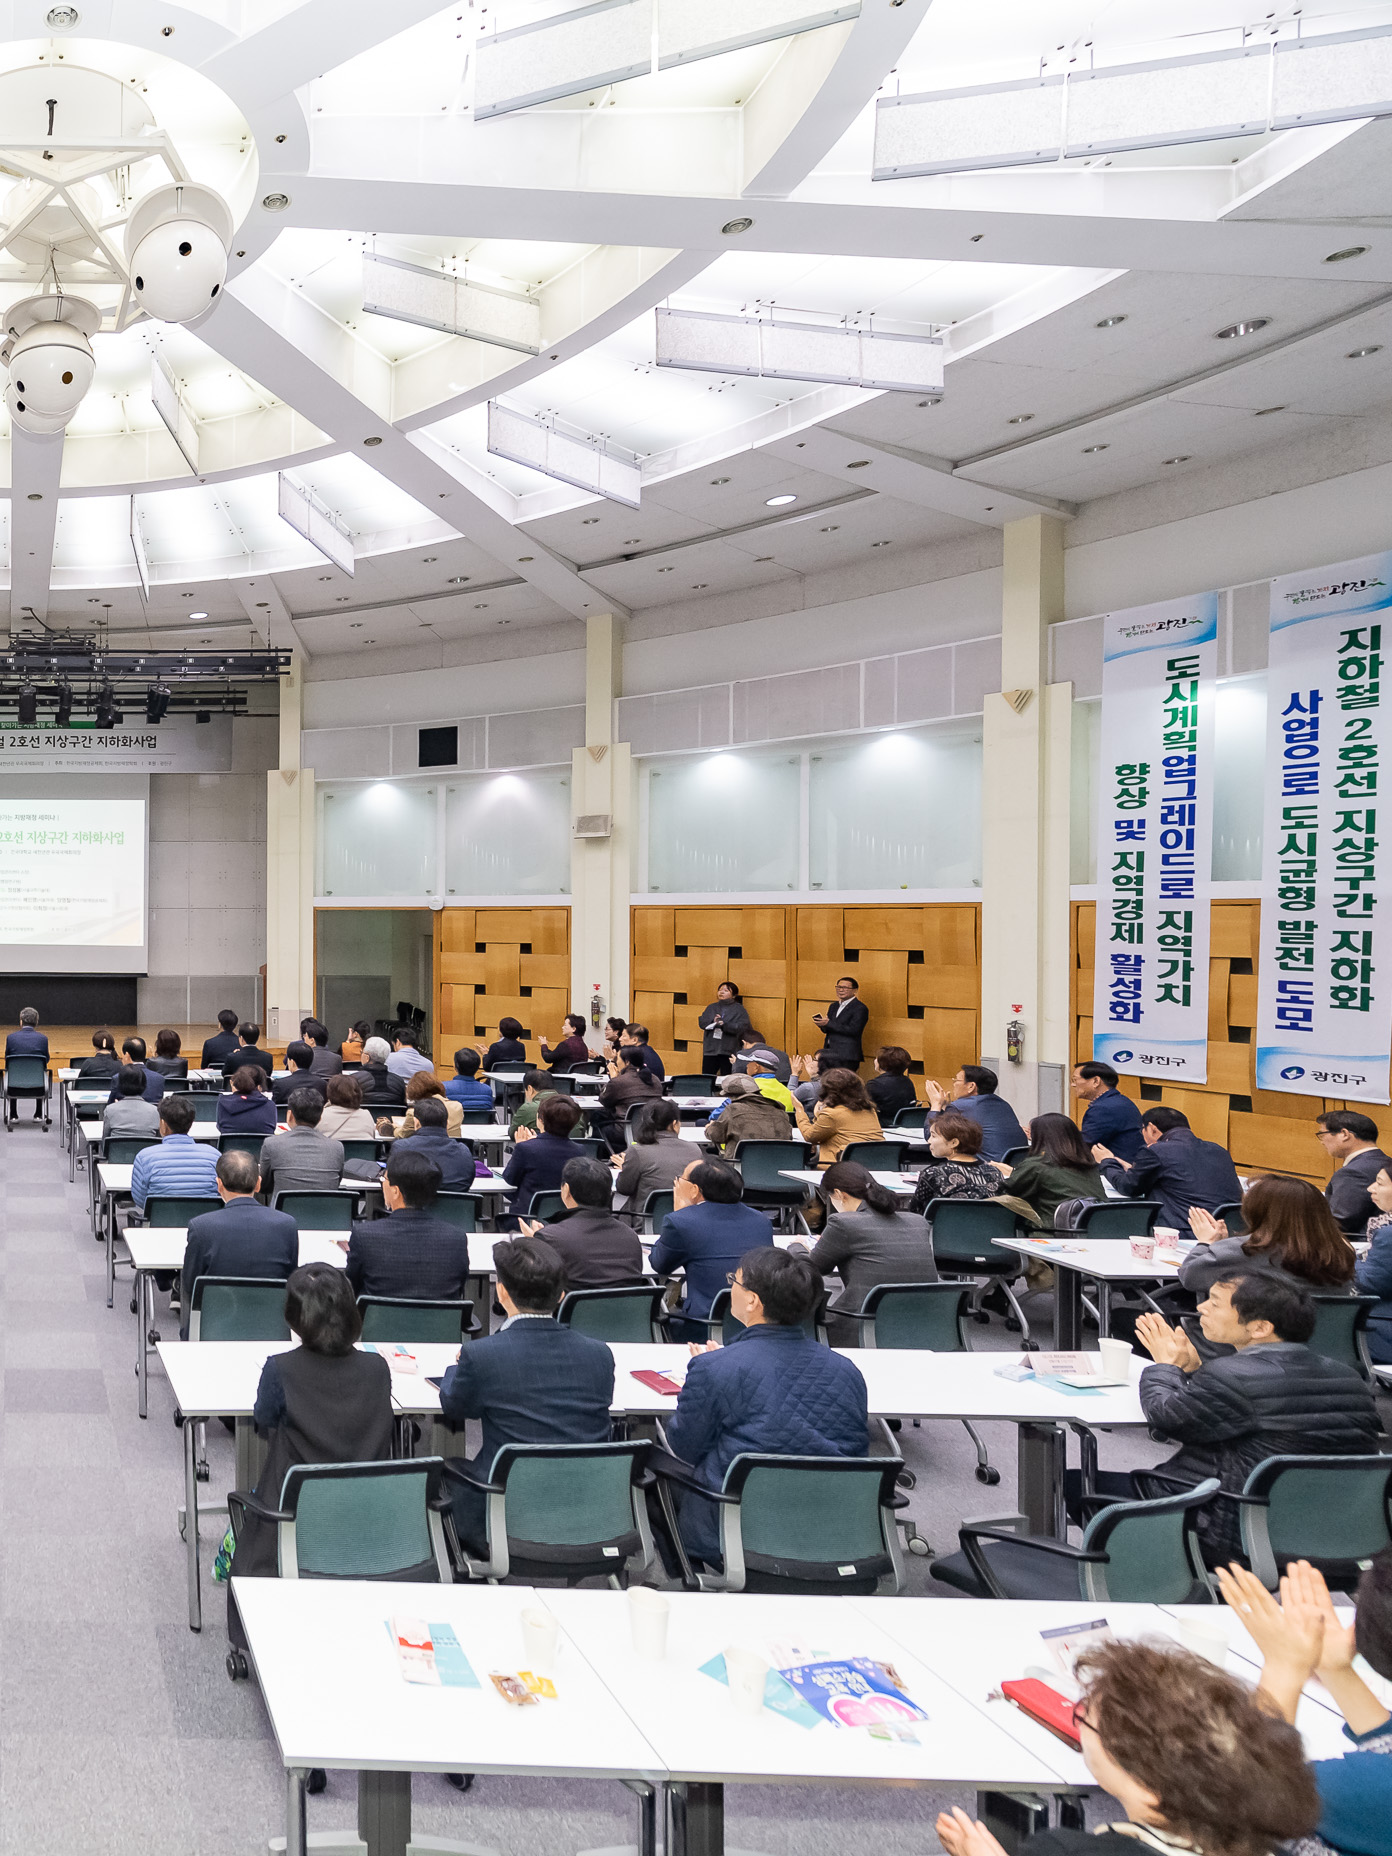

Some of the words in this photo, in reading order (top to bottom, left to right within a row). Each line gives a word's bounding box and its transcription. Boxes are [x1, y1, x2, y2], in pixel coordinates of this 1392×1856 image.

[1329, 580, 1368, 595] 광진
[1156, 618, 1189, 631] 광진
[1336, 624, 1384, 711] 지하철
[9, 736, 41, 749] 2호선
[45, 735, 93, 748] 지상구간
[97, 735, 157, 749] 지하화사업
[1281, 689, 1324, 796] 사업으로
[1333, 718, 1379, 798] 2호선
[1113, 762, 1151, 810] 향상
[1159, 655, 1201, 899] 도시계획업그레이드로
[27, 831, 69, 844] 지상구간
[72, 831, 125, 845] 지하화사업
[1114, 818, 1146, 842] 및
[1277, 805, 1319, 911] 도시균형
[1332, 808, 1379, 919] 지상구간
[1109, 851, 1146, 944] 지역경제
[1154, 910, 1195, 1007] 지역가치
[1274, 920, 1318, 972] 발전
[1329, 930, 1376, 1012] 지하화
[1108, 953, 1145, 1024] 활성화
[1274, 980, 1314, 1032] 도모
[1138, 1053, 1187, 1067] 광진구
[1310, 1070, 1367, 1086] 광진구
